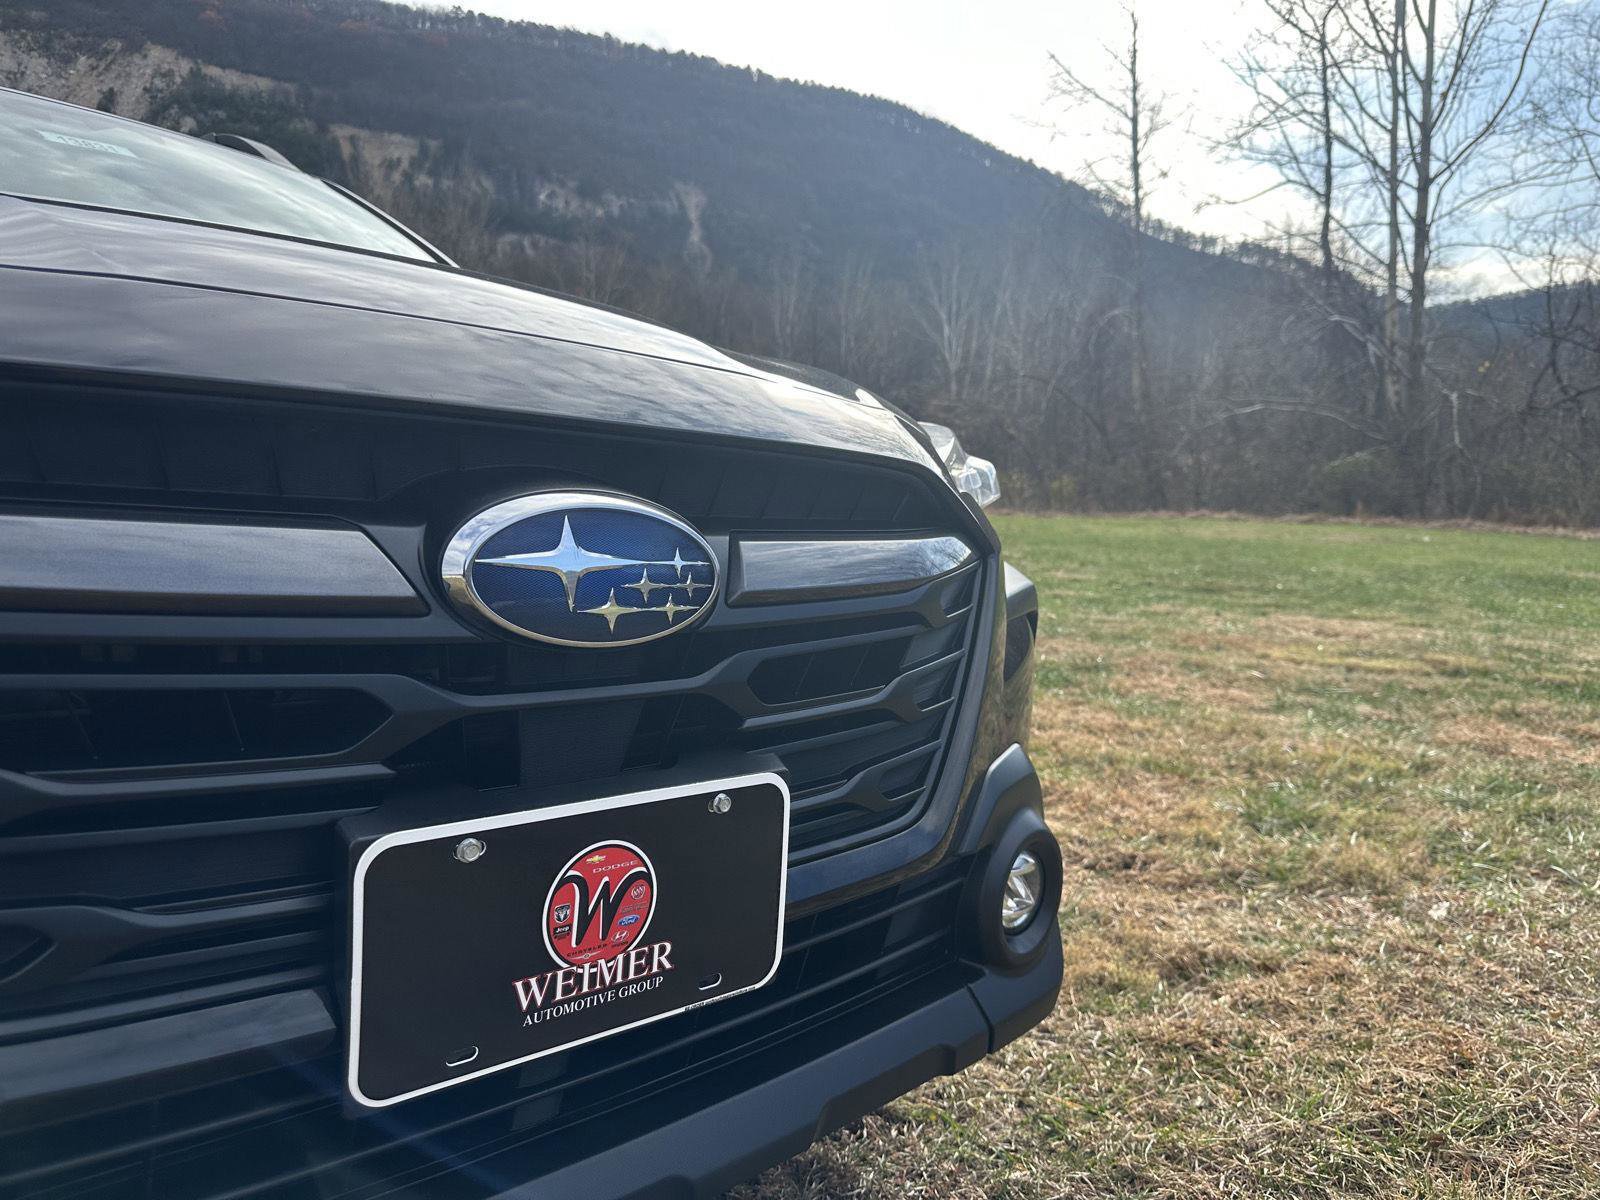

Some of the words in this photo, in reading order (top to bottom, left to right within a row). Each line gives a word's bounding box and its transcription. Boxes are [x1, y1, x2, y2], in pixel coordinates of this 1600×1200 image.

[592, 860, 640, 873] DODGE
[512, 940, 674, 1012] WEIMER
[522, 987, 616, 1027] AUTOMOTIVE
[618, 976, 664, 998] GROUP
